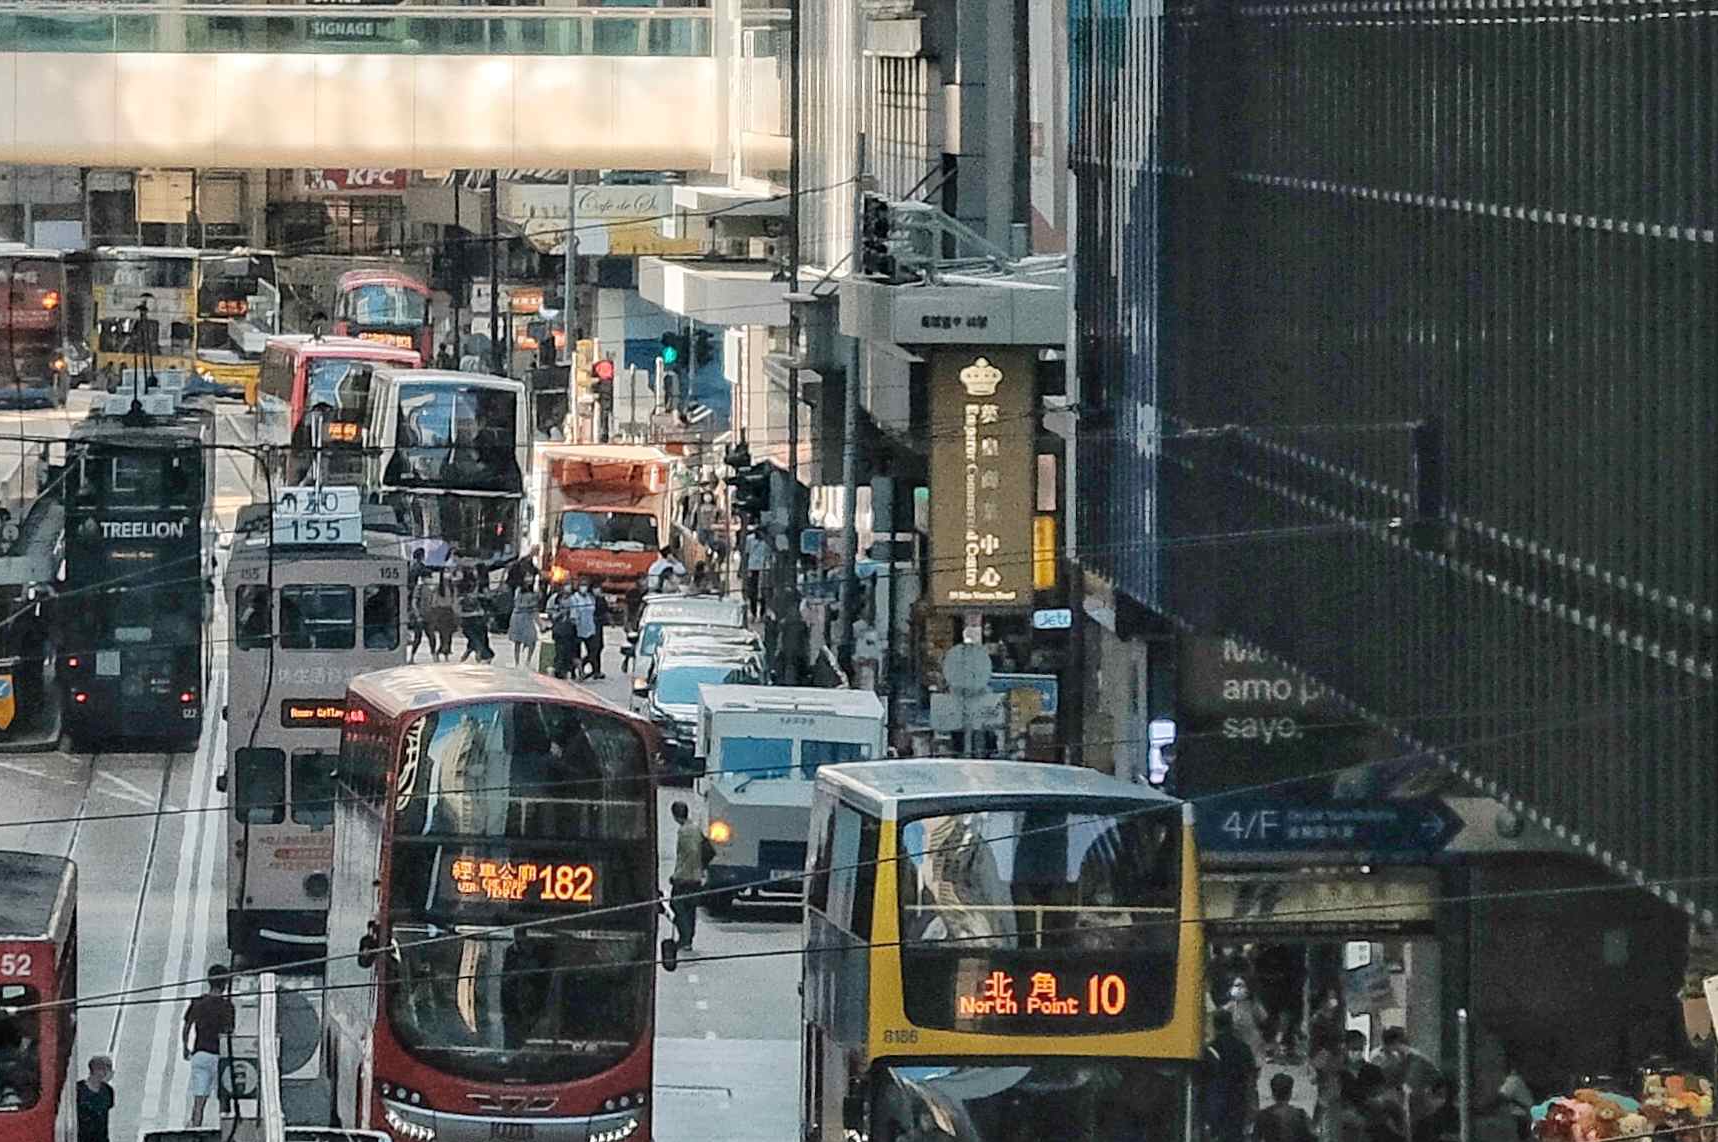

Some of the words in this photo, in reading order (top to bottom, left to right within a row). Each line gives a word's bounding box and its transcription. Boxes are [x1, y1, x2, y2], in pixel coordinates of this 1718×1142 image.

[312, 22, 376, 36] SIGNAGE
[346, 168, 394, 185] KFC
[101, 521, 184, 539] TREELION
[290, 519, 341, 542] 155
[379, 567, 400, 579] 155
[1223, 678, 1292, 701] amo
[1221, 810, 1279, 840] 4/F
[539, 865, 594, 902] 182
[0, 953, 33, 977] 52
[984, 971, 1057, 998] 北角
[1088, 973, 1126, 1015] 10
[960, 997, 1017, 1014] North
[1027, 997, 1079, 1014] Point
